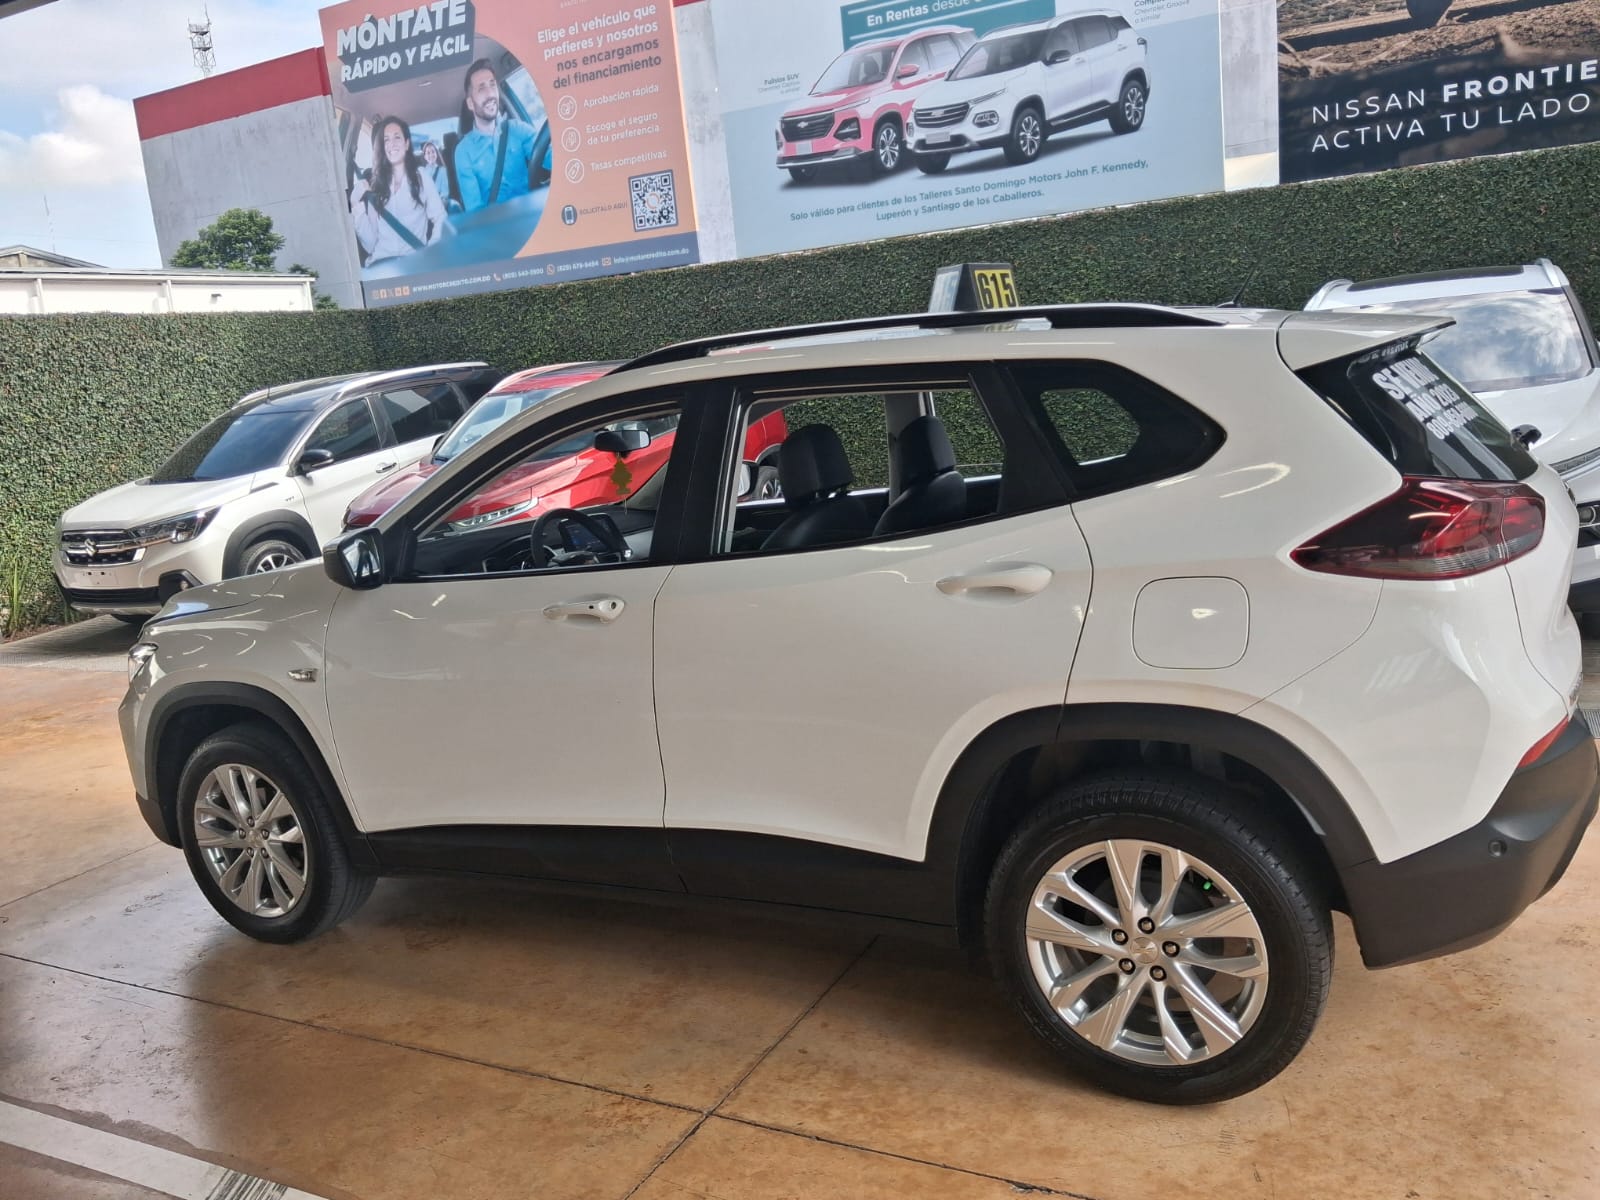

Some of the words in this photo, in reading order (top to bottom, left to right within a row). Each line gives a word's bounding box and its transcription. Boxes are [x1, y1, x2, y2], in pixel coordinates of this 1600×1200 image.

[336, 0, 466, 56] MÓNTATE
[537, 28, 565, 43] Elige
[568, 22, 579, 35] el
[581, 10, 630, 31] vehículo
[633, 4, 656, 20] que
[866, 14, 883, 27] En
[886, 4, 929, 22] Rentas
[543, 38, 594, 60] prefieres
[596, 35, 603, 47] y
[606, 22, 658, 43] nosotros
[557, 59, 578, 72] nos
[582, 39, 659, 65] encargamos
[341, 52, 401, 82] RÁPIDO
[405, 46, 417, 66] Y
[420, 34, 470, 62] FÁCIL
[553, 74, 571, 89] del
[573, 55, 662, 83] financiamiento
[583, 90, 630, 108] Aprobación
[632, 84, 659, 97] rápida
[1312, 88, 1425, 124] NISSAN
[1443, 59, 1598, 103] FRONTIE
[586, 121, 616, 133] Escoge
[618, 117, 626, 126] el
[628, 112, 658, 125] seguro
[587, 137, 598, 146] de
[600, 134, 609, 143] tu
[611, 124, 660, 142] preferencia
[1311, 119, 1425, 153] ACTIVA
[1440, 109, 1480, 132] TU
[1498, 93, 1590, 124] LADO
[591, 161, 612, 172] Tasas
[614, 150, 668, 167] competitivas
[790, 212, 808, 221] Solo
[810, 207, 835, 218] válido
[836, 205, 855, 216] para
[856, 199, 889, 210] clientes
[891, 197, 902, 206] de
[904, 194, 918, 204] los
[919, 190, 952, 201] Talleres
[955, 185, 981, 195] Santo
[983, 178, 1026, 190] Domingo
[1029, 173, 1062, 183] Motors
[1064, 168, 1089, 179] John
[1091, 166, 1100, 175] F.
[1102, 159, 1149, 173] Kennedy,
[876, 208, 911, 221] Luperón
[914, 208, 919, 216] y
[921, 200, 961, 214] Santiago
[963, 199, 975, 207] de
[976, 196, 990, 206] los
[992, 189, 1044, 203] Caballeros.
[976, 272, 1016, 309] 615
[1372, 367, 1412, 400] SE
[1405, 392, 1442, 422] AÑO
